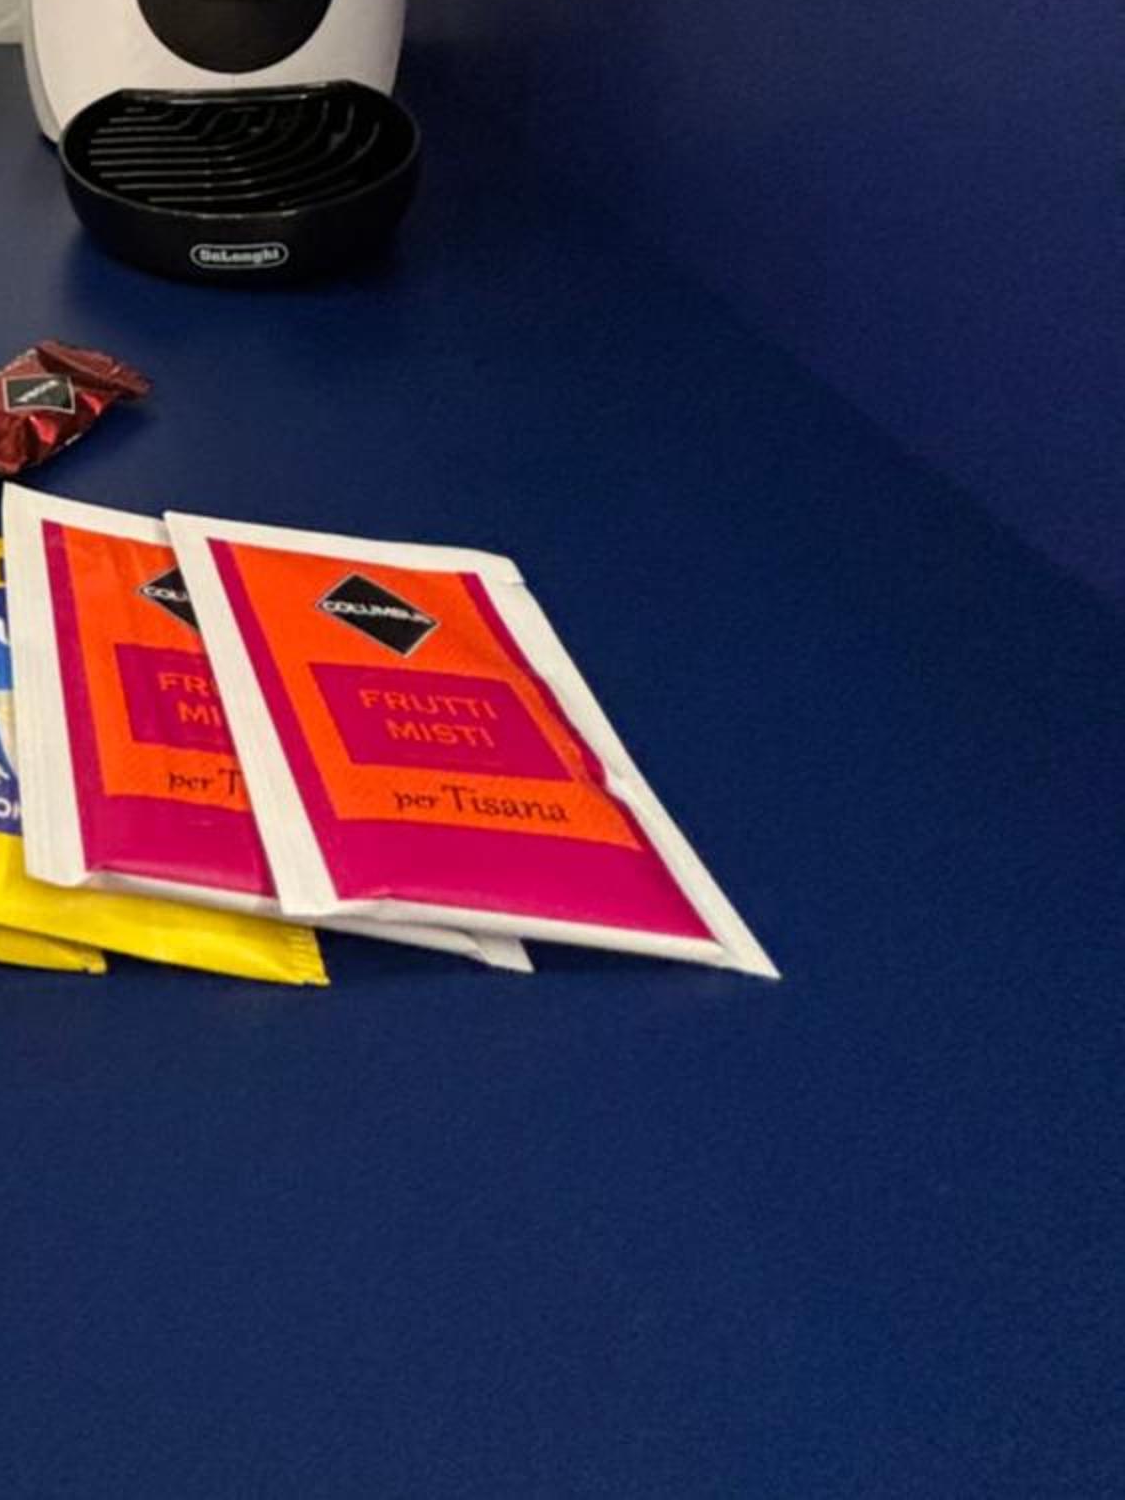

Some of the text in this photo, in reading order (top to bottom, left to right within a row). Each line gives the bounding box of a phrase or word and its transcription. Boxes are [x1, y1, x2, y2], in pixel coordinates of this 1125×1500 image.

[359, 688, 497, 721] FRUTTI
[386, 718, 495, 749] MISTI
[168, 771, 214, 793] per
[394, 784, 571, 823] per Tisana
